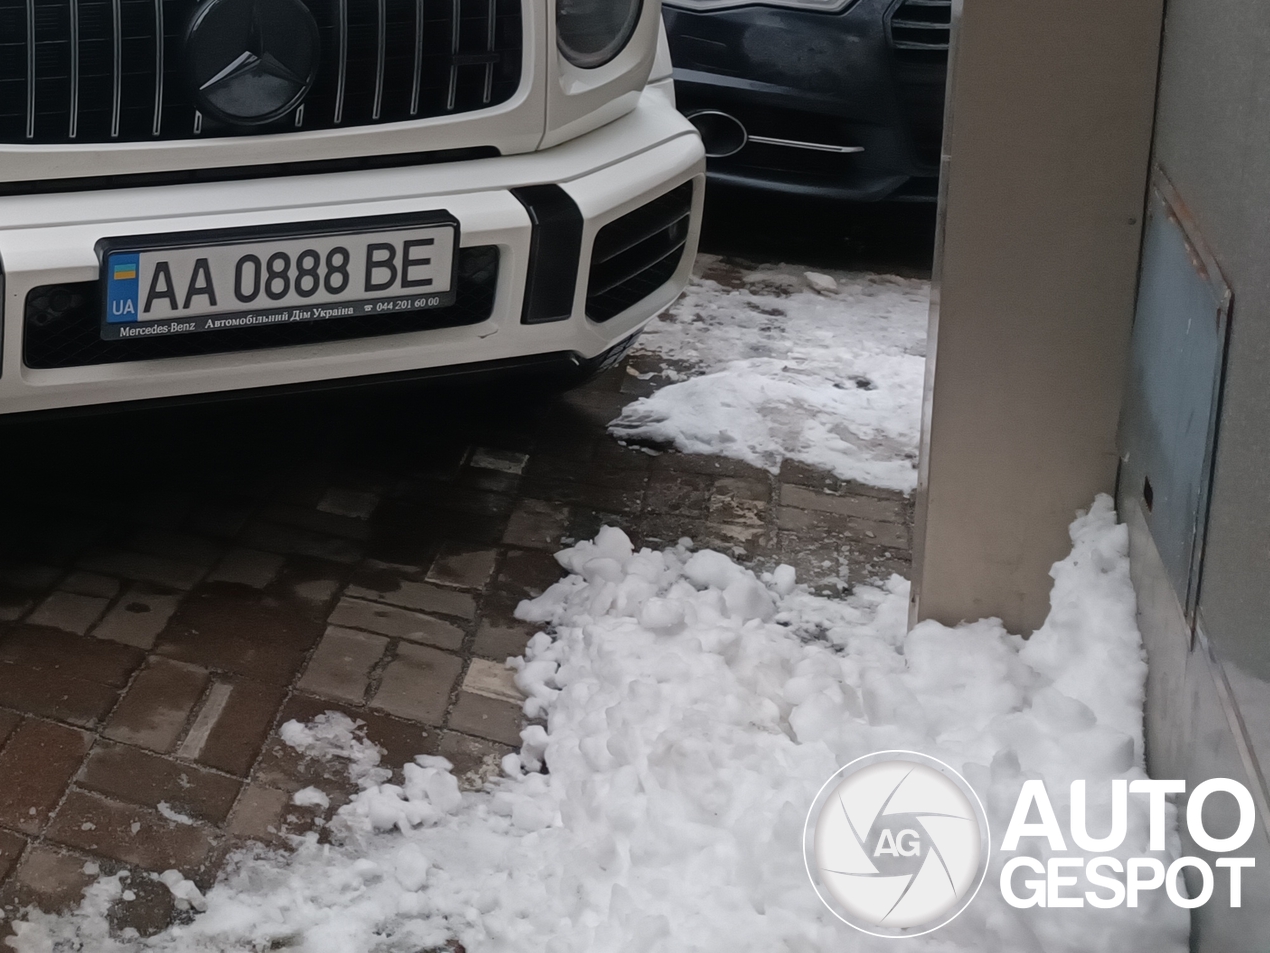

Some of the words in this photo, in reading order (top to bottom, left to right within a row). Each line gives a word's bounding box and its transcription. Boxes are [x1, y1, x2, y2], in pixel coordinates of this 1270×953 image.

[143, 258, 217, 313] AA
[234, 246, 350, 304] 0888
[364, 238, 435, 293] BE
[112, 299, 135, 315] UA
[119, 322, 196, 337] Mercedes-Benz
[204, 311, 289, 329] Автомобільний
[290, 309, 311, 321] Дім
[313, 306, 354, 319] Україна
[376, 301, 394, 311] 044
[395, 300, 411, 310] 201
[414, 298, 426, 308] 60
